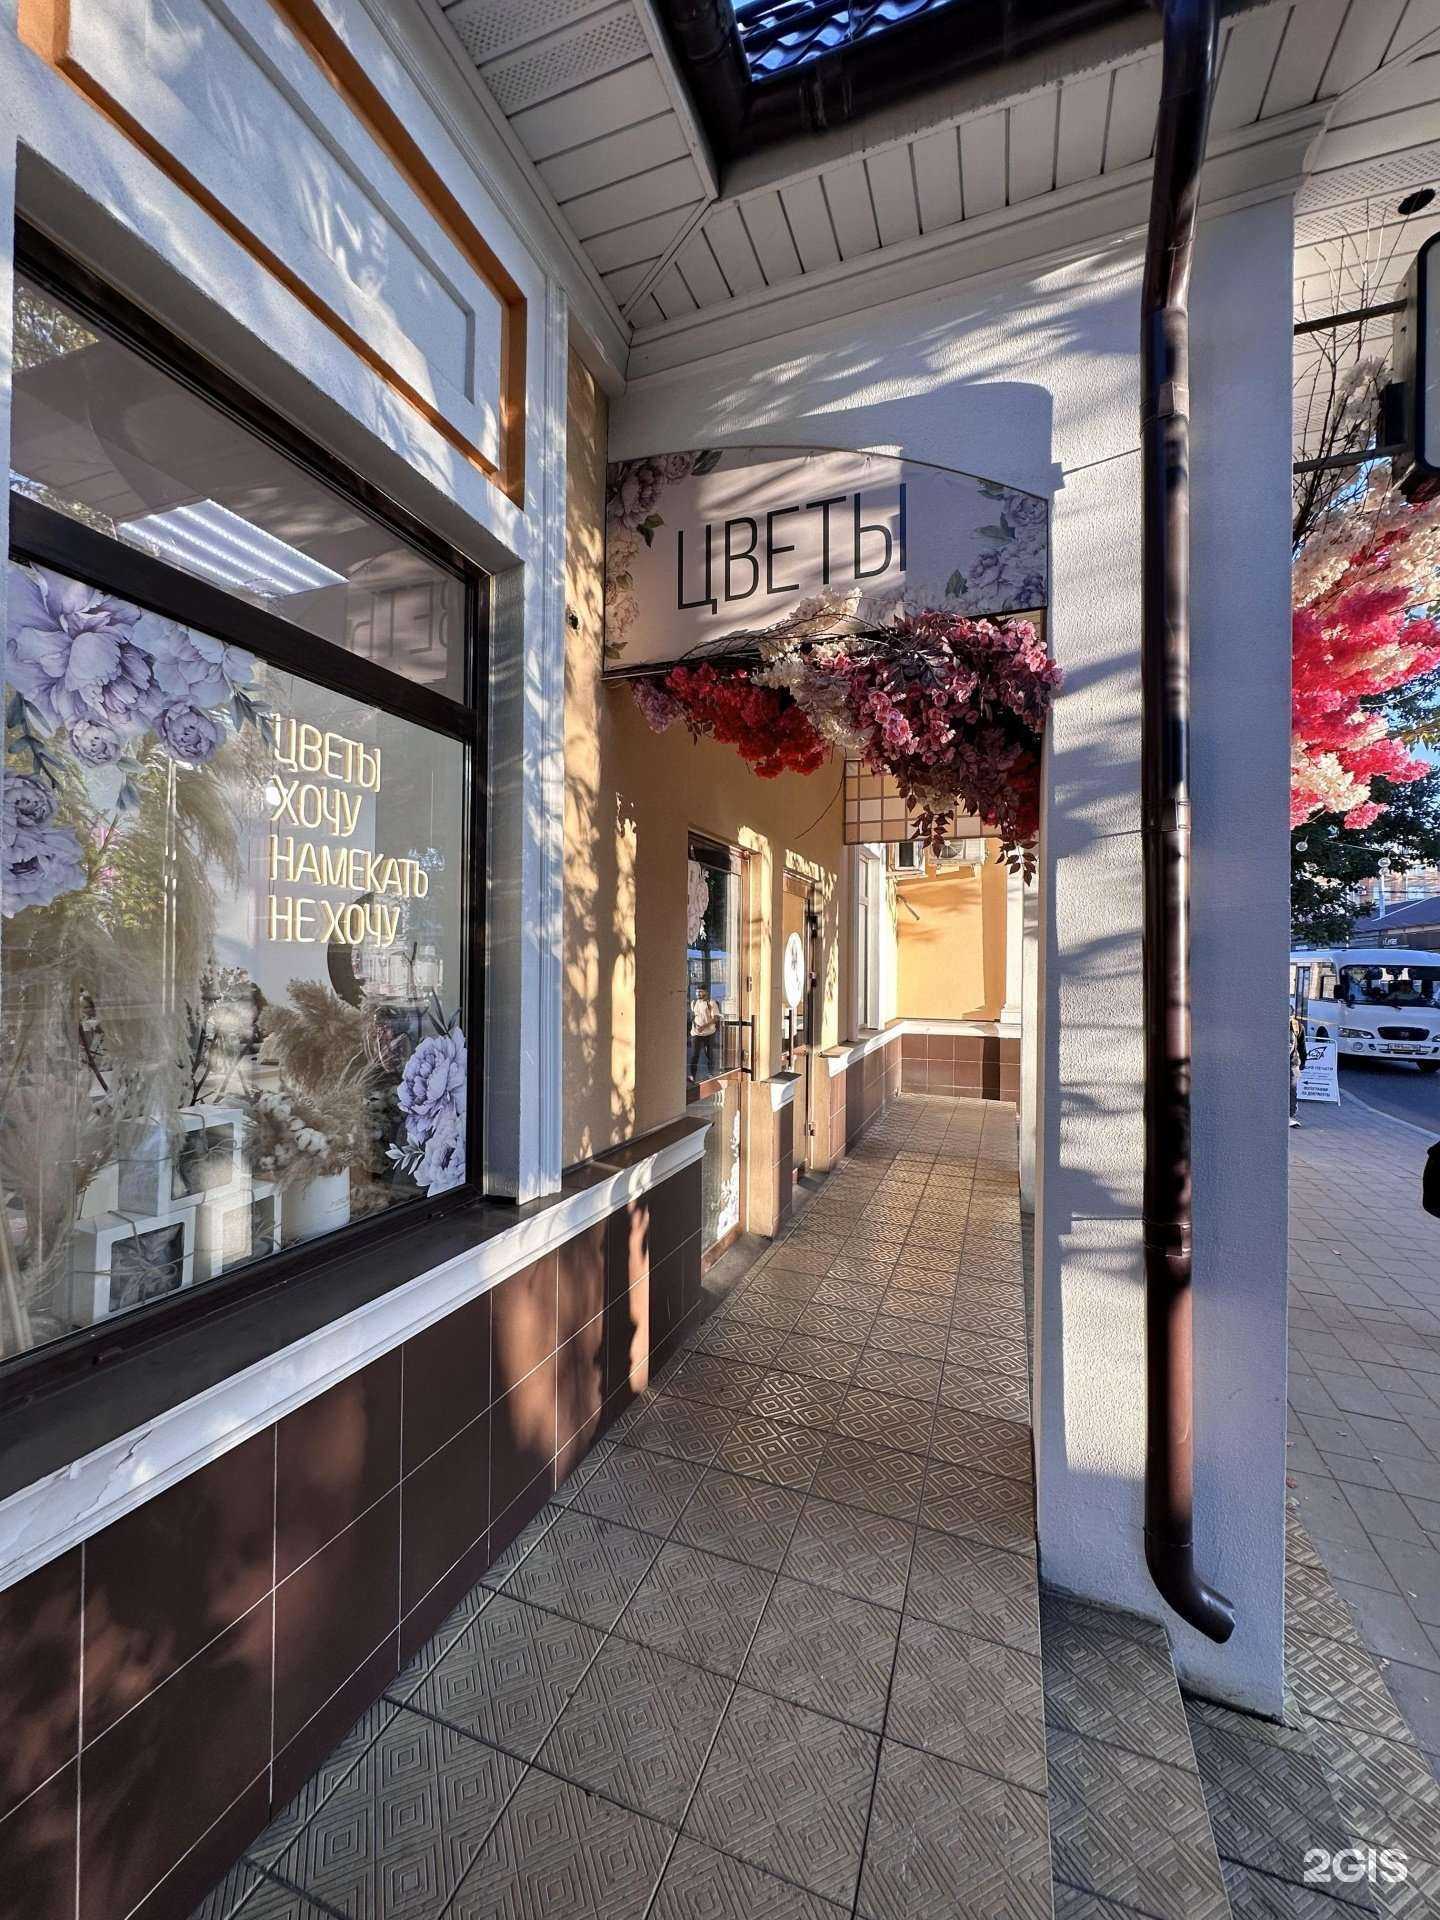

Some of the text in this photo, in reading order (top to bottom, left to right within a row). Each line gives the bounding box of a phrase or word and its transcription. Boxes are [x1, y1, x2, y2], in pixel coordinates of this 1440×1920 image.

[677, 482, 907, 615] ЦВЕТЫ
[272, 713, 381, 792] ЦВЕТЫ
[270, 774, 362, 836] ХОЧУ
[269, 834, 429, 897] НАМЕКАТЬ
[268, 894, 400, 947] НЕ ХОЧУ
